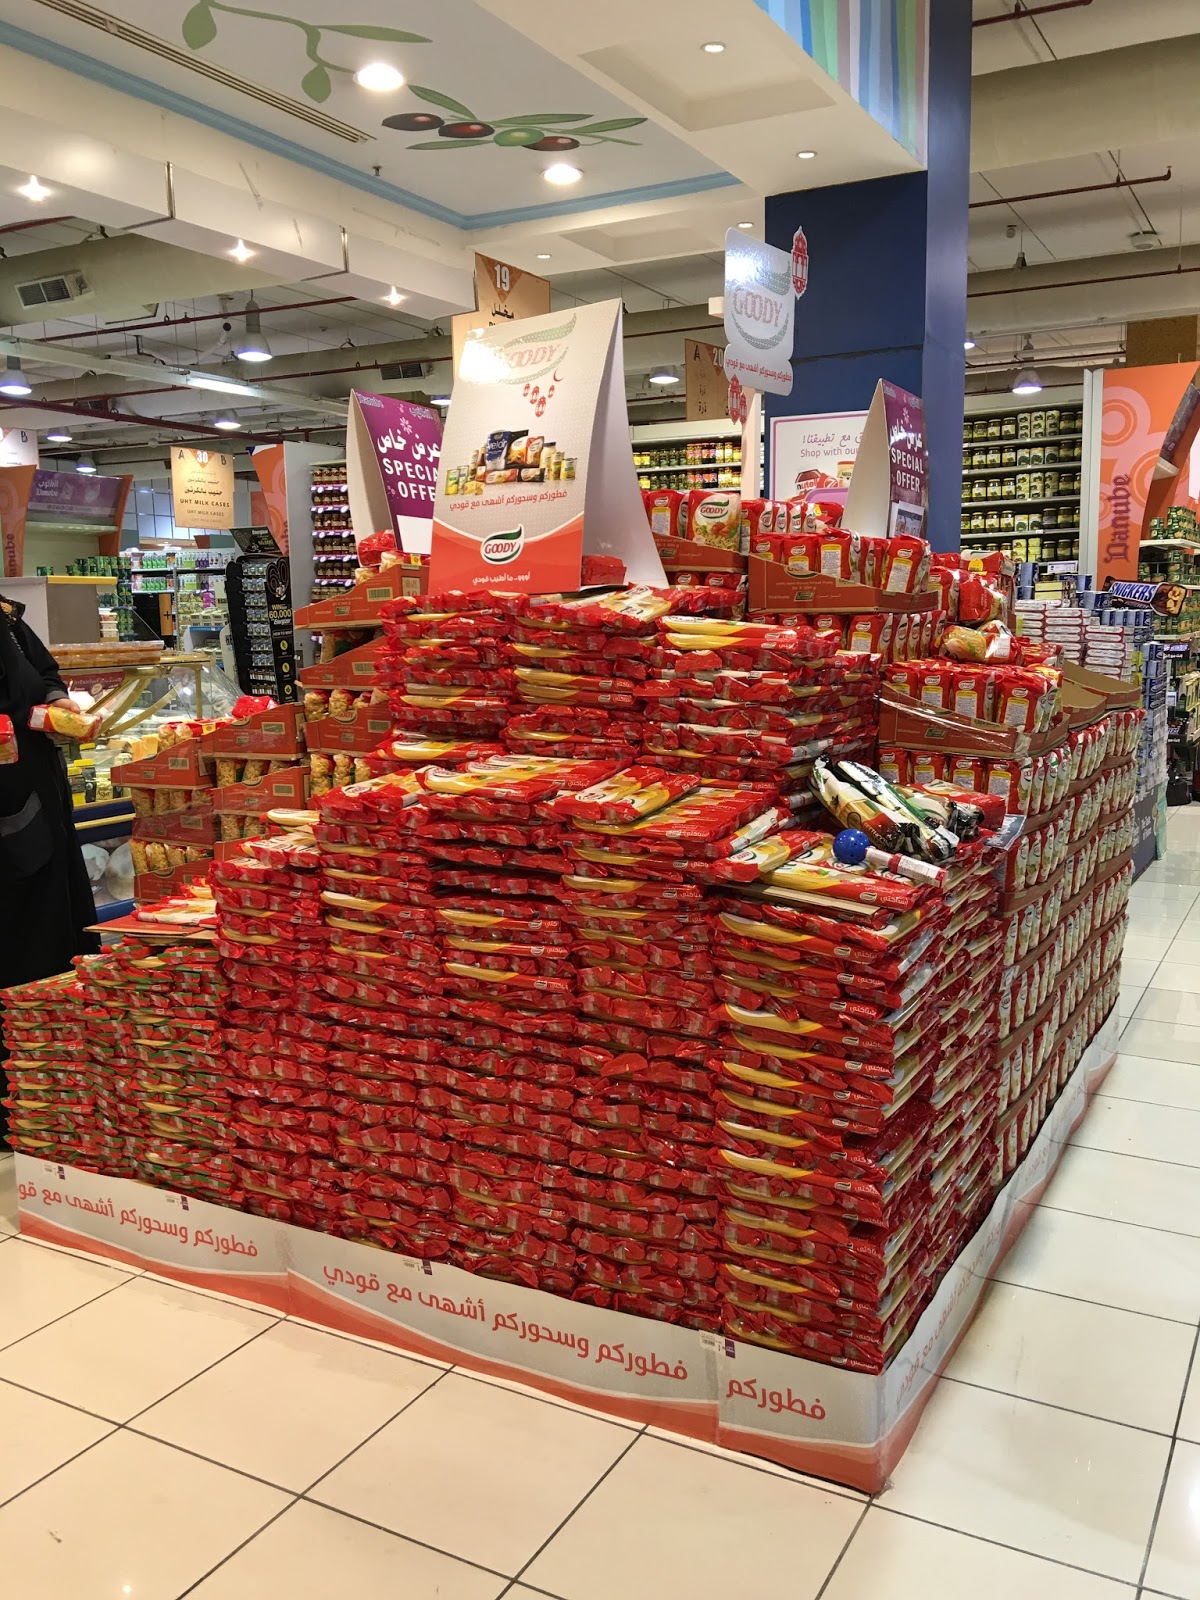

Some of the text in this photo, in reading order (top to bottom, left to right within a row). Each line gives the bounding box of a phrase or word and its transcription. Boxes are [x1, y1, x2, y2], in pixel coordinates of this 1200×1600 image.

[494, 263, 510, 292] 19
[733, 287, 783, 327] GOODY
[505, 343, 561, 369] OODY
[712, 347, 724, 368] 20
[377, 428, 407, 454] خاص
[800, 447, 859, 459] Shop with ou
[178, 449, 227, 466] A 30 B
[382, 458, 439, 482] SPECIA
[890, 447, 924, 474] SPECIAL
[397, 481, 436, 502] OFFE
[896, 472, 920, 492] OFFER
[449, 489, 568, 512] فطوركم وسحوركم أشهى مع قودي
[700, 506, 726, 515] GOODY
[1103, 473, 1131, 564] Danube
[7, 533, 16, 577] anube
[484, 541, 517, 555] GOODY
[1112, 582, 1157, 601] SNICKERS
[269, 609, 292, 619] 60,000
[18, 1181, 258, 1257] فطوركم وسحوركم أشهى مع قو
[324, 1264, 380, 1293] قودي
[387, 1283, 412, 1302] مع
[418, 1291, 486, 1322] أشهى
[492, 1312, 589, 1358] وسحوركم
[595, 1342, 688, 1380] فطوركم
[726, 1376, 826, 1421] فطوركم
